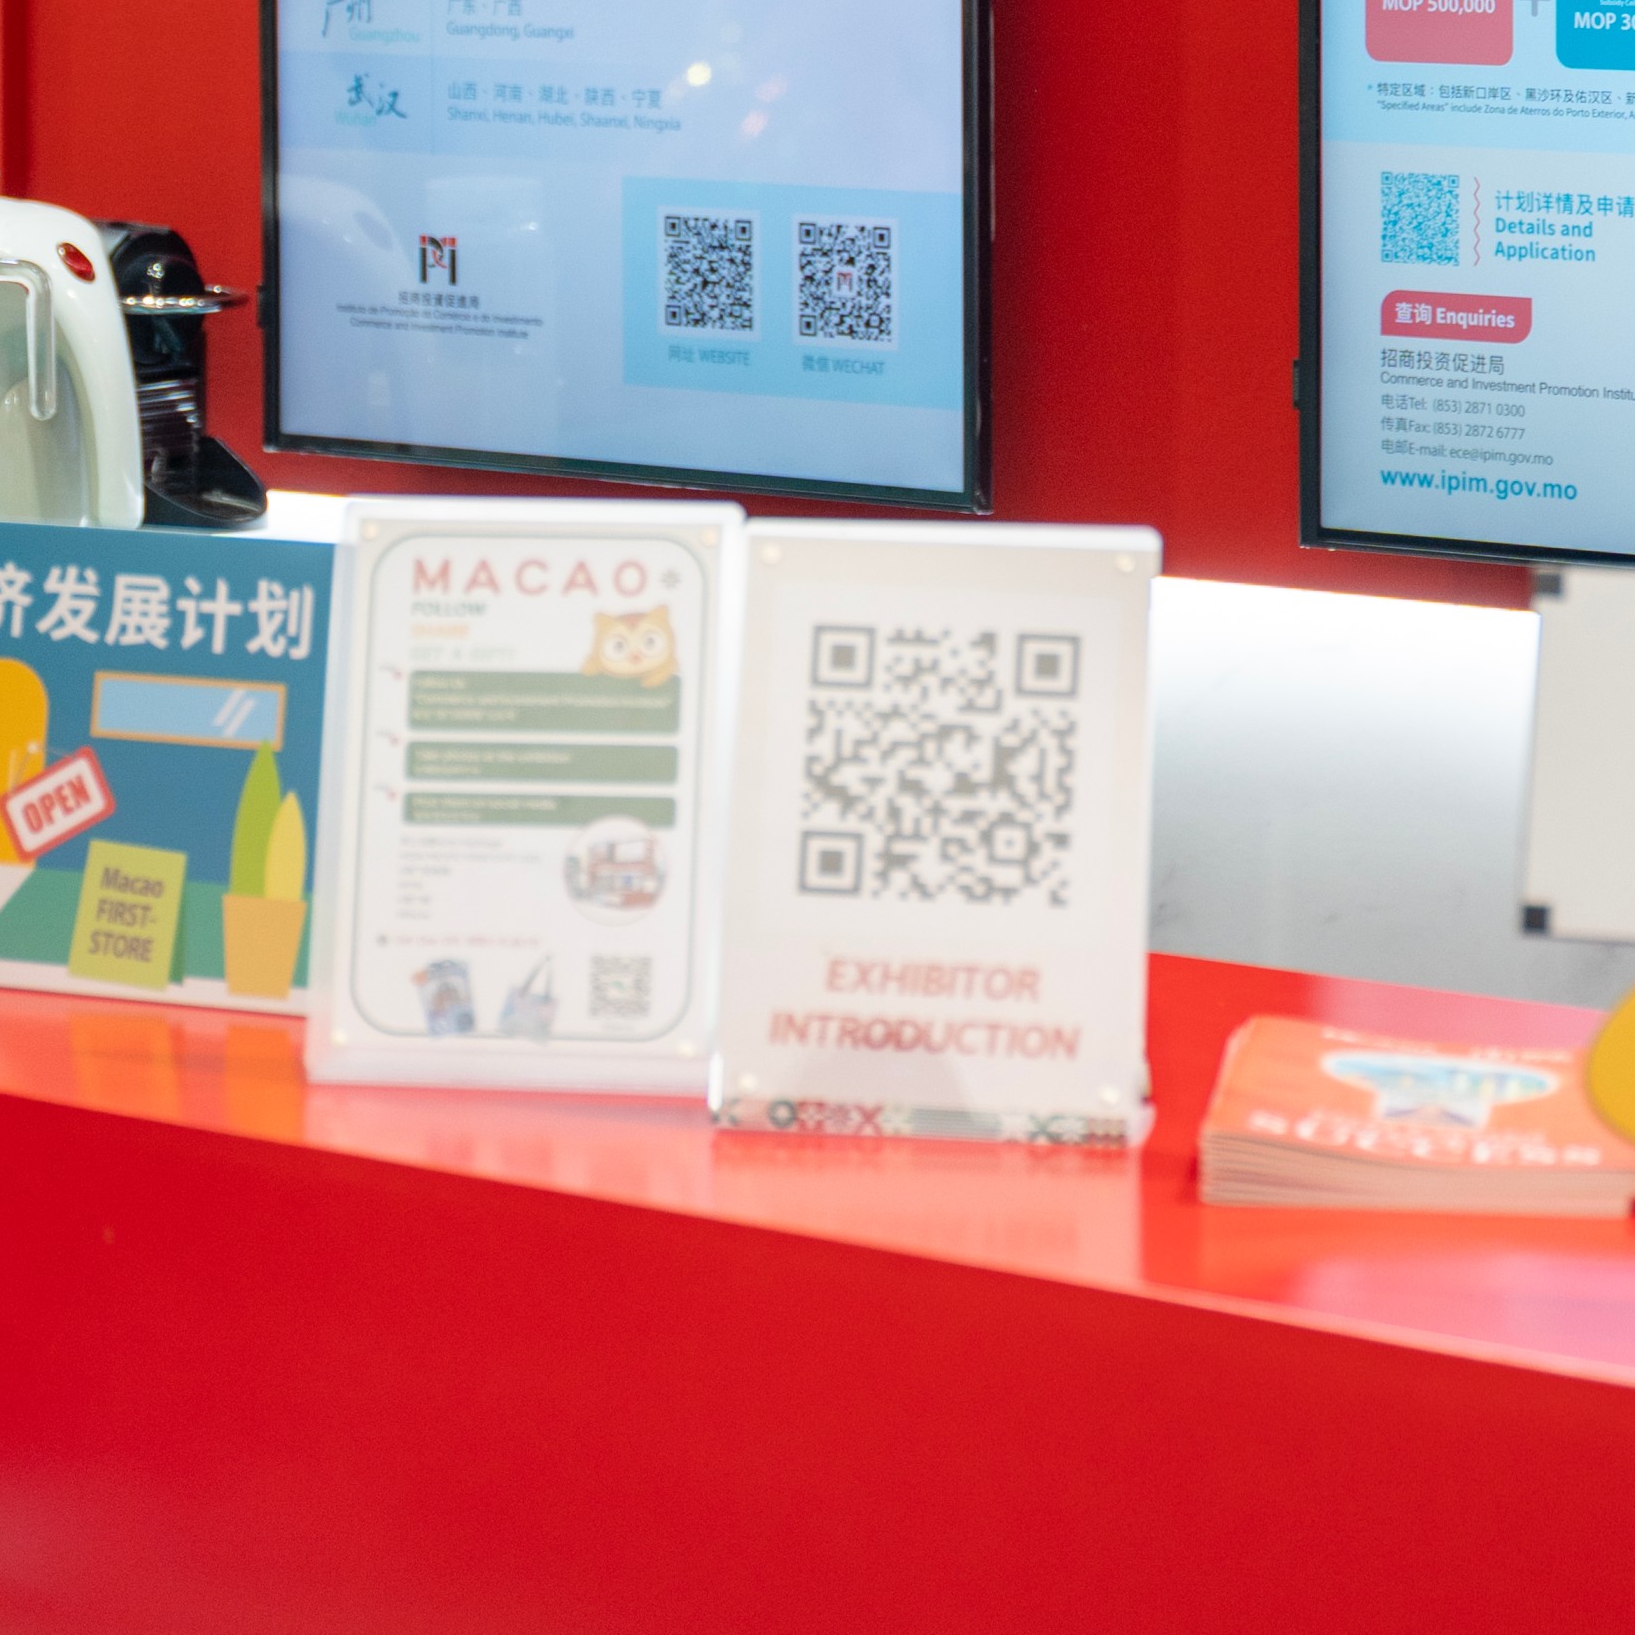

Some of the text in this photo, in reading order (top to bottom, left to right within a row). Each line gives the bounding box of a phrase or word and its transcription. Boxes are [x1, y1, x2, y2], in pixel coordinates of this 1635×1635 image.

[1495, 190, 1635, 218] 计划详情及申请
[1396, 302, 1515, 329] 查询 Enquiries
[698, 348, 750, 366] WEBSITE
[831, 359, 885, 375] WECHAT
[1380, 469, 1578, 501] www.ipim.gov.mo
[412, 557, 649, 598] MACAO
[20, 773, 90, 834] OPEN
[100, 866, 164, 898] Macao
[96, 897, 155, 927] FIRST-
[88, 929, 154, 962] STORE
[825, 956, 1041, 1001] EXHIBITOR
[772, 1014, 1079, 1058] INTRODUCTION
